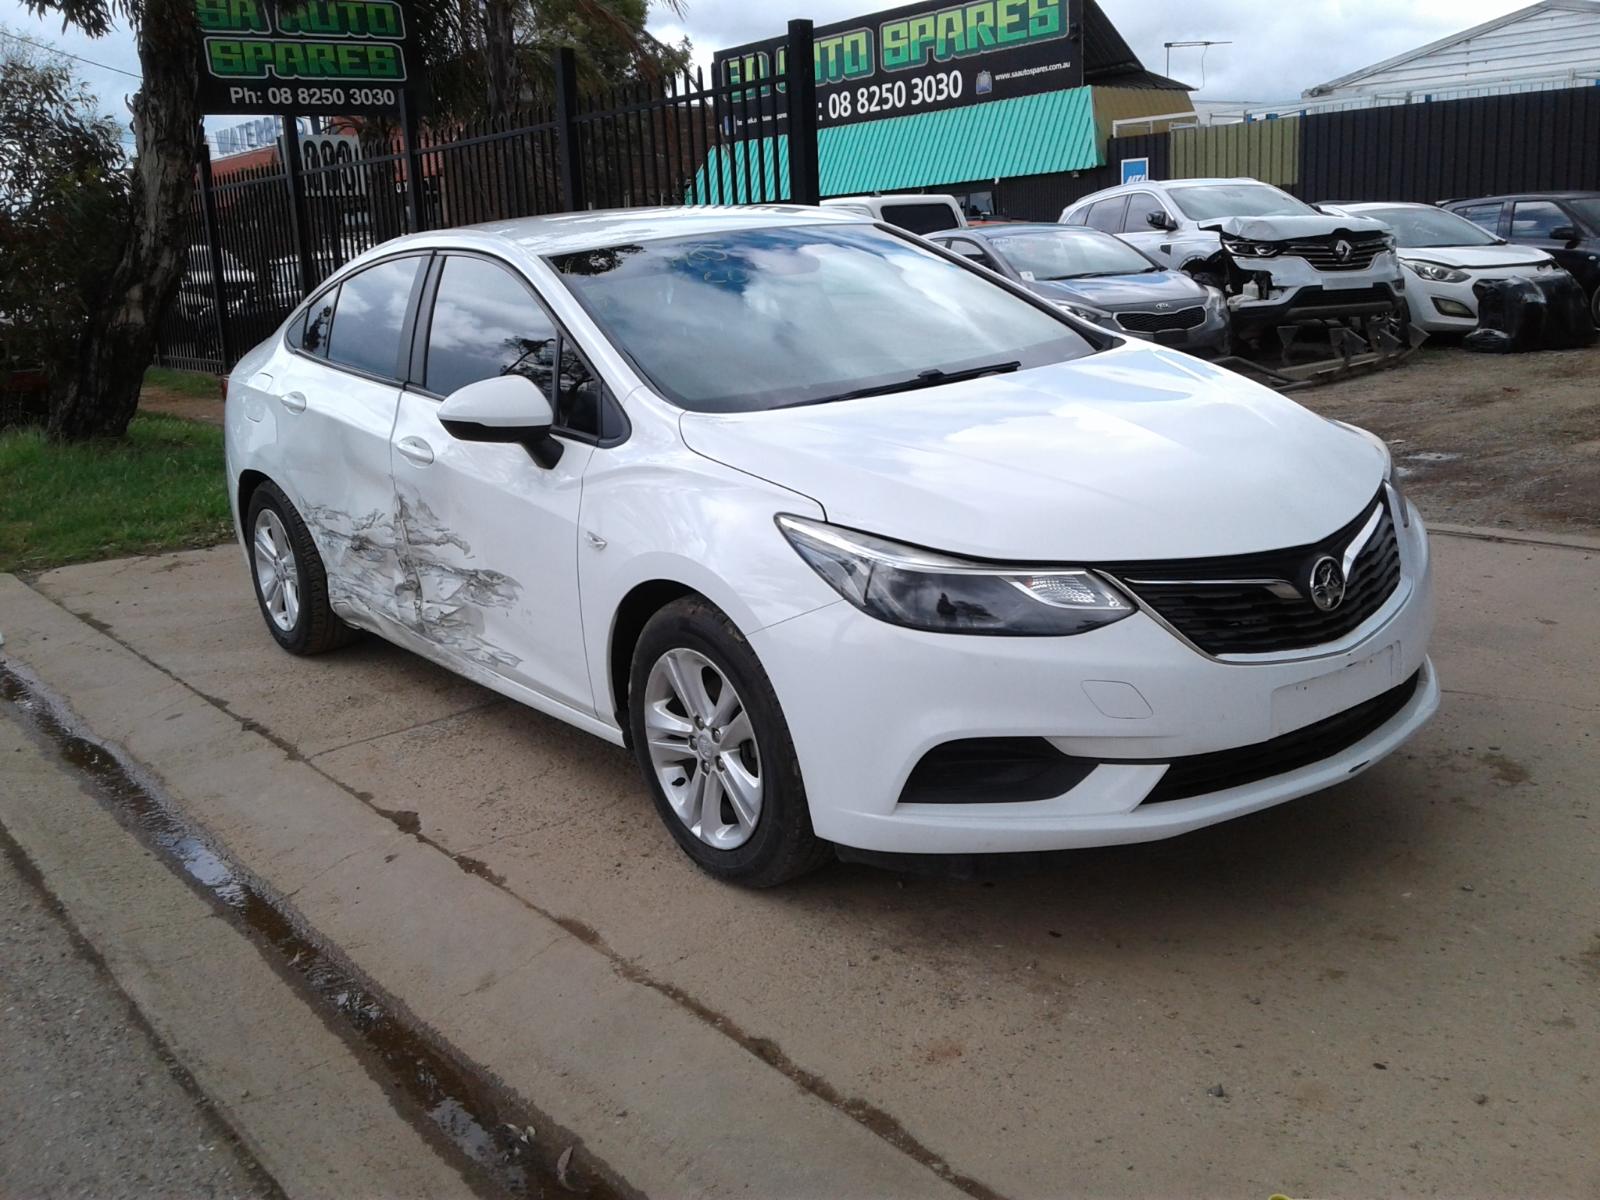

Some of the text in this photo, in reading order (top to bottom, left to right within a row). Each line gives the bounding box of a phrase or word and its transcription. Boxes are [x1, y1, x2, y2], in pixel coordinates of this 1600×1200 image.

[883, 0, 1060, 66] SPARES
[208, 40, 399, 77] SPARES
[995, 61, 1071, 81] www.saautospares.com.au
[230, 87, 396, 106] Ph: 08 8250 3030
[828, 91, 852, 119] 08
[856, 80, 907, 114] 8250
[910, 69, 963, 106] 3030
